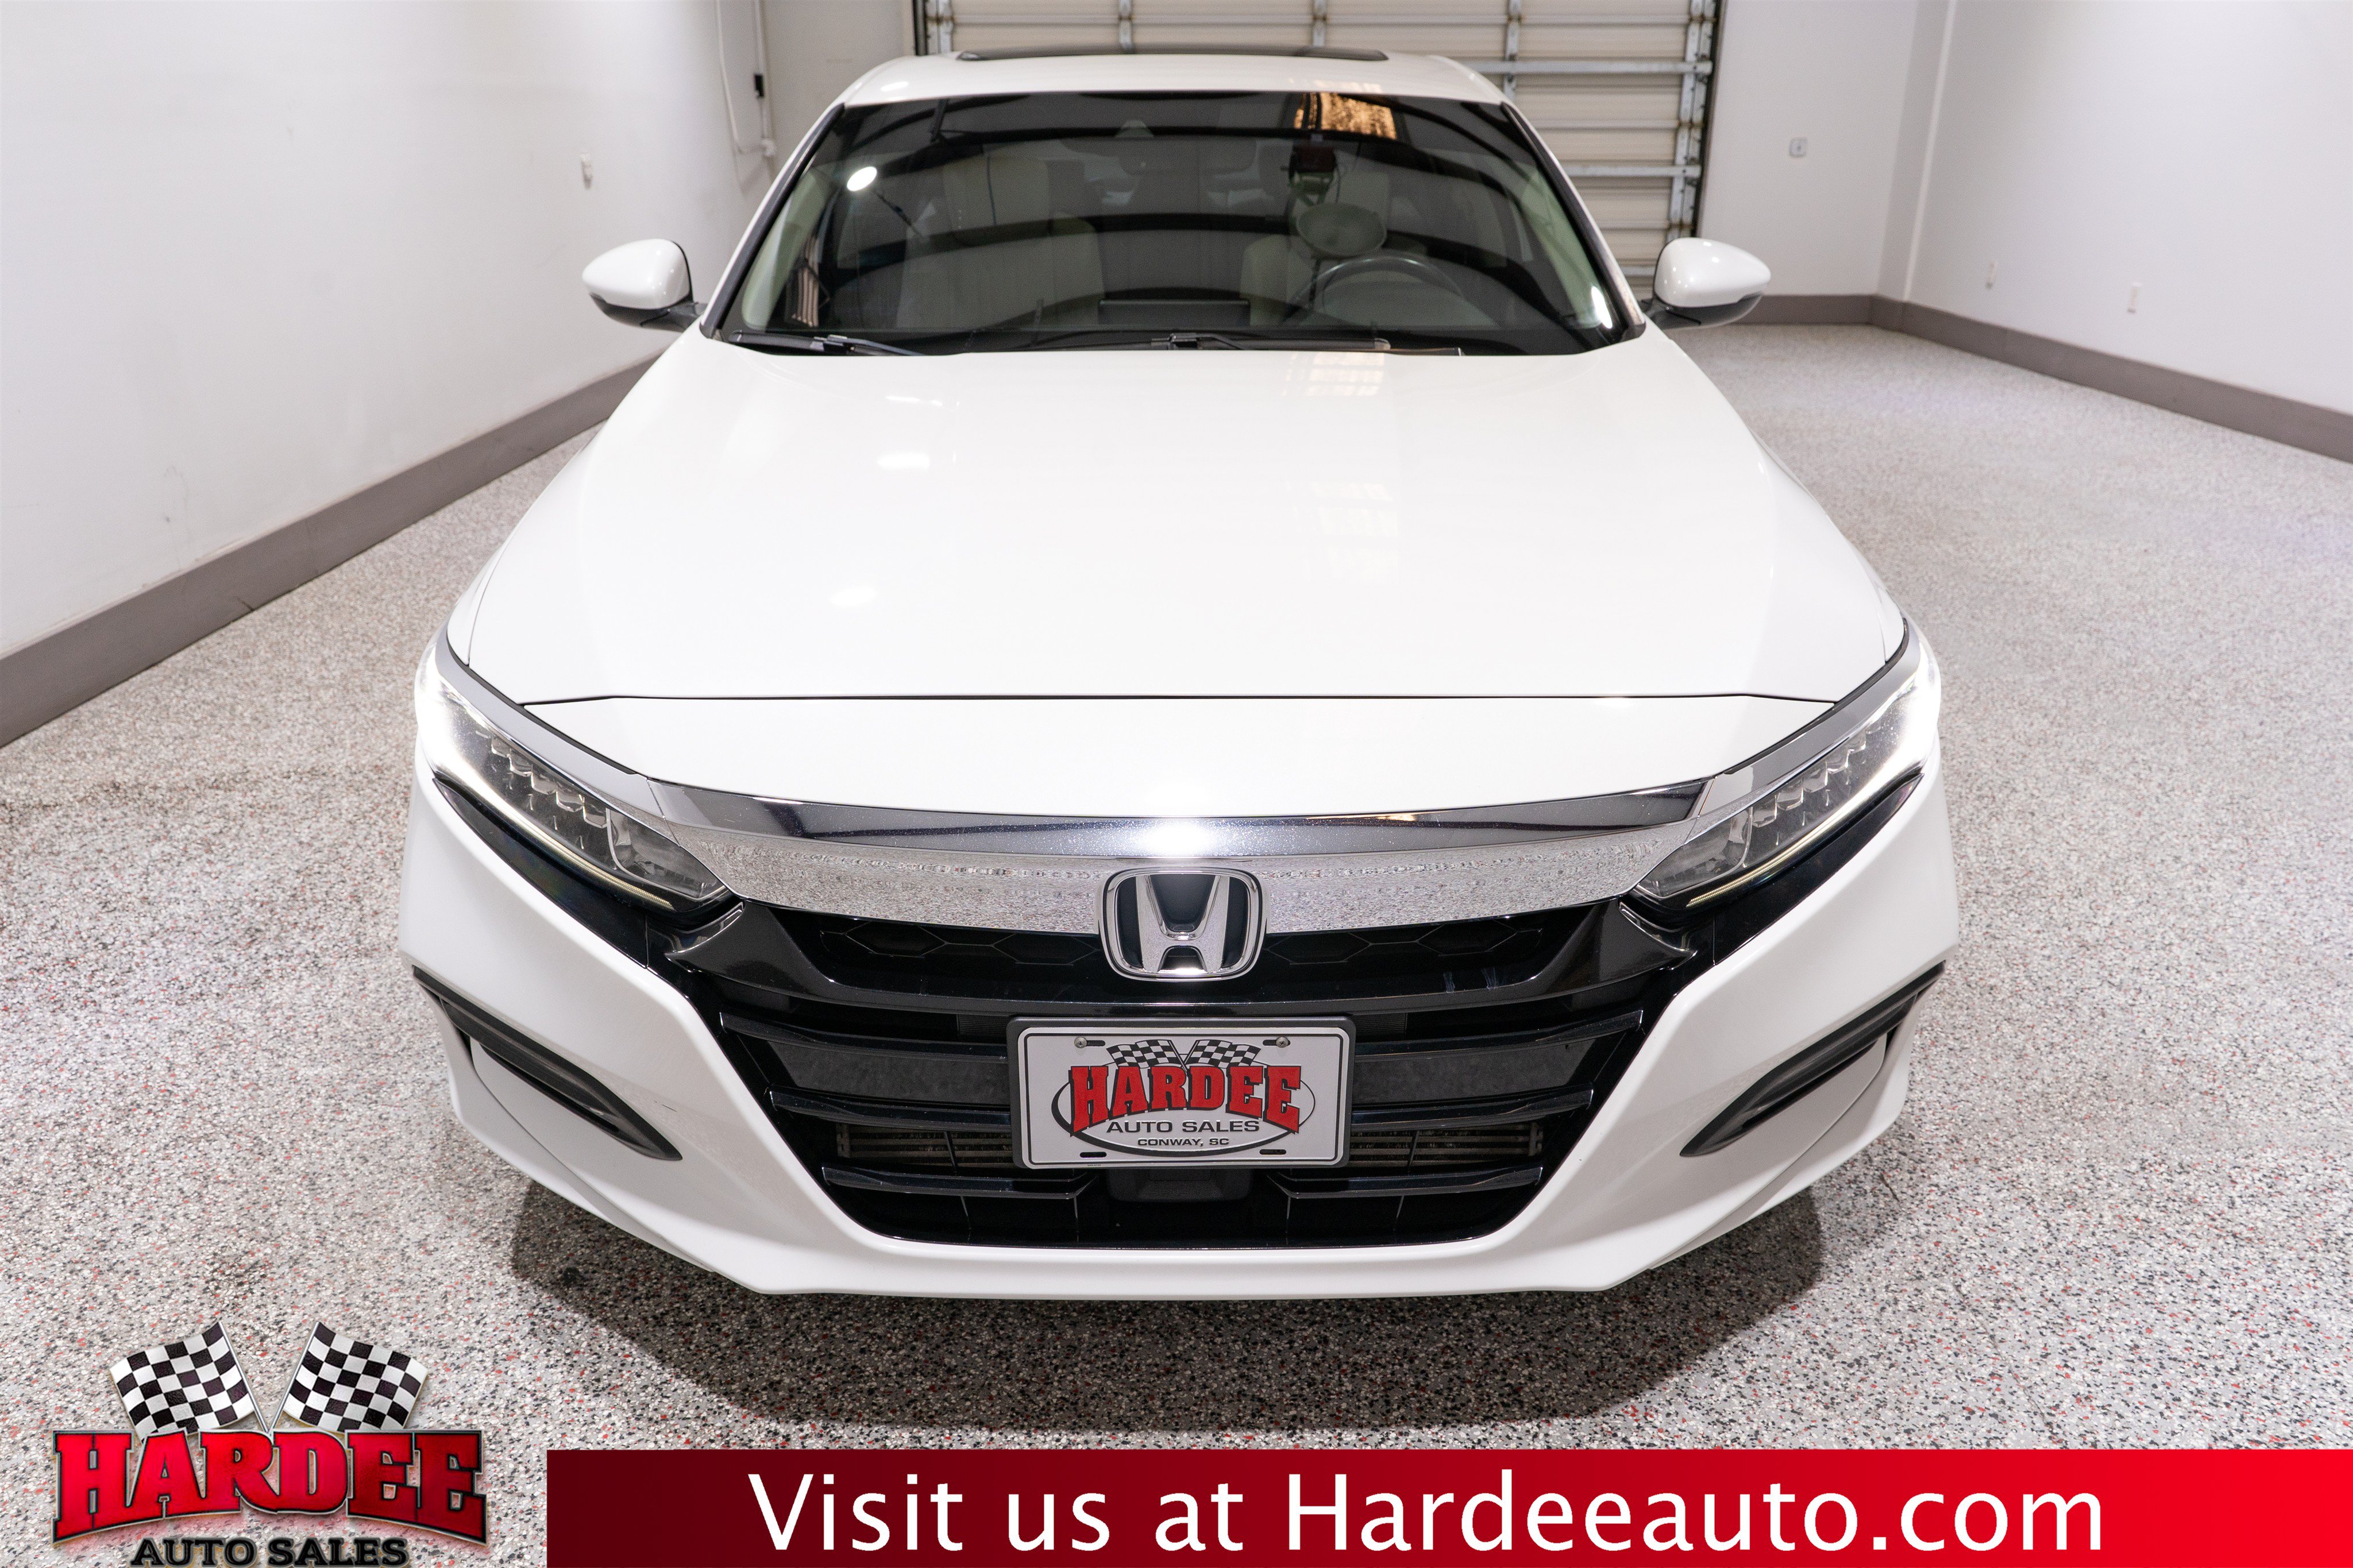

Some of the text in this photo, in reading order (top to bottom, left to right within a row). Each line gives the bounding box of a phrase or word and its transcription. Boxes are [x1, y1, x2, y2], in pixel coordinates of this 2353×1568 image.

[1069, 1065, 1302, 1136] HARDEE
[1106, 1120, 1260, 1133] AUTO SALES
[1137, 1138, 1204, 1146] CONWAY,
